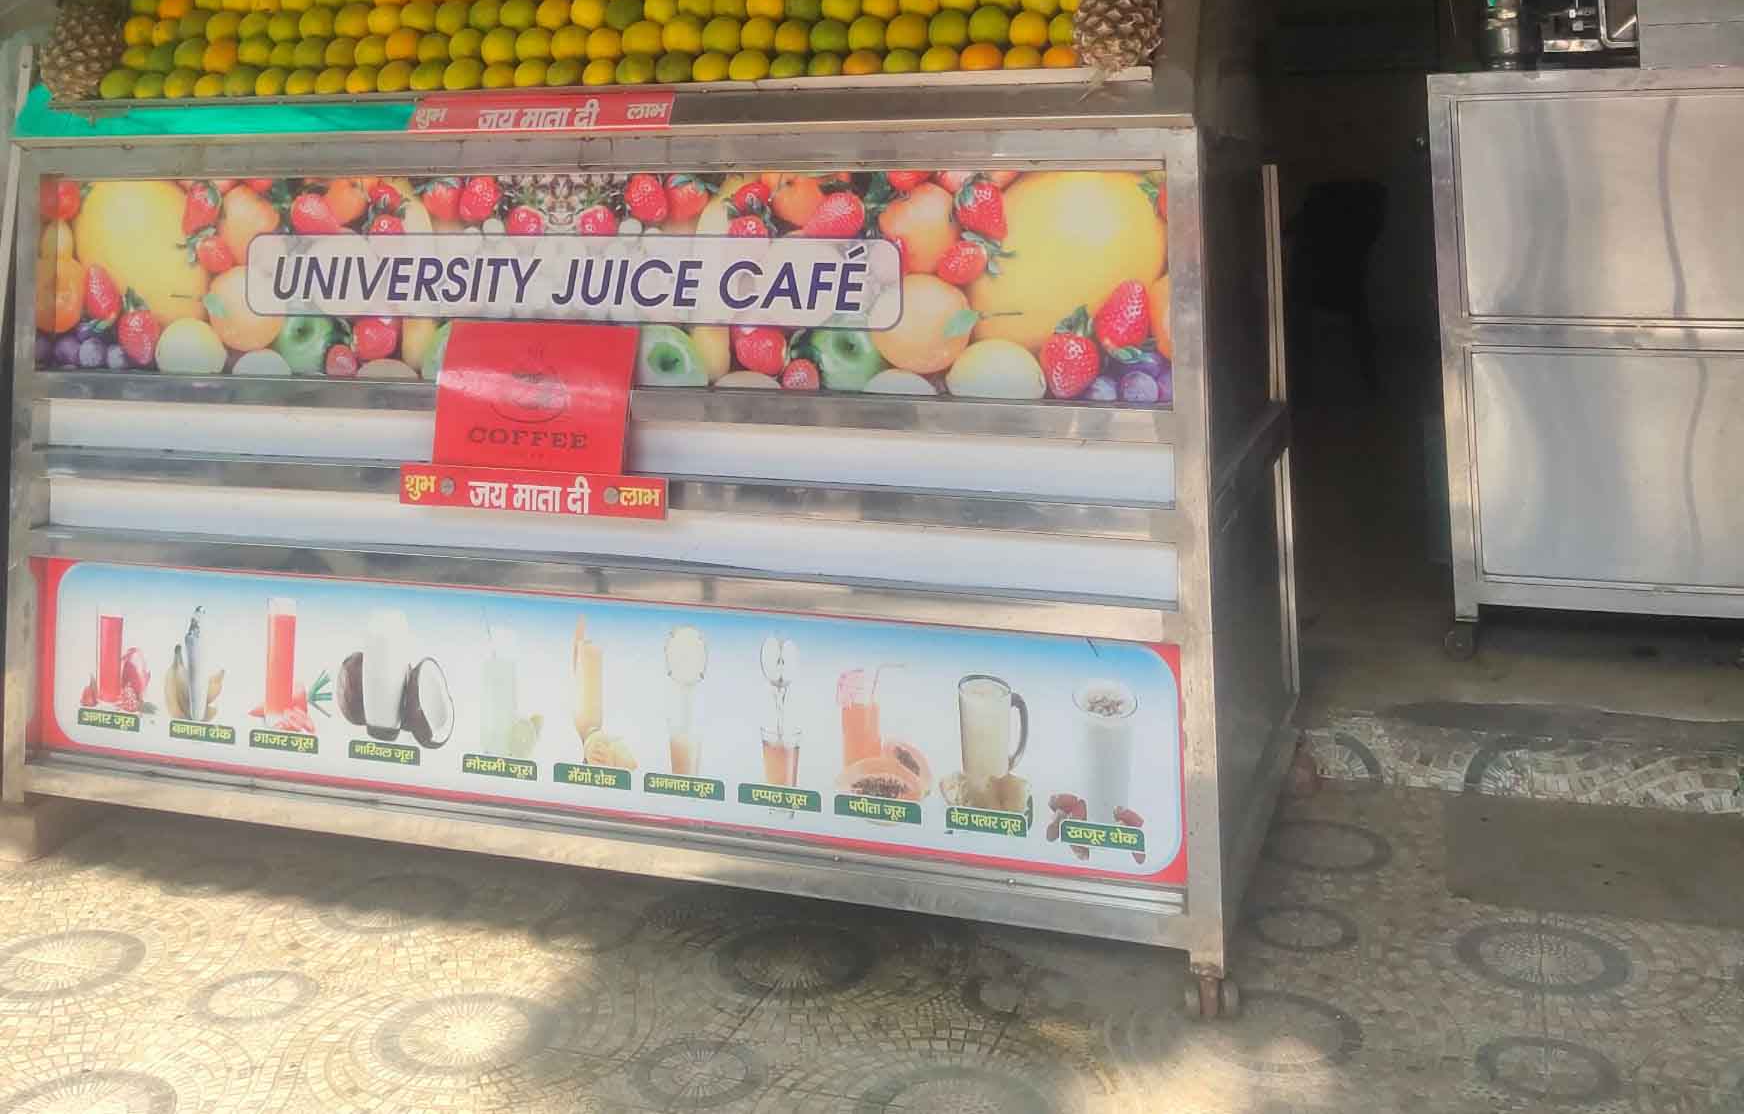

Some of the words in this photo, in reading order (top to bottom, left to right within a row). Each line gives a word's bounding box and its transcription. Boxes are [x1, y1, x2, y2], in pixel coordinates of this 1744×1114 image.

[415, 107, 448, 129] शुभ
[478, 109, 515, 130] जय
[519, 106, 571, 129] माता
[573, 98, 600, 128] दी
[626, 102, 669, 120] लाभ
[272, 254, 542, 304] UNIVERSITY
[550, 257, 700, 307] JUICE
[719, 244, 869, 312] CAFÉ
[467, 426, 588, 451] COFFEE
[404, 474, 436, 501] शुभ
[467, 481, 508, 509] जय
[512, 483, 562, 513] माता
[566, 475, 592, 514] दी
[618, 486, 662, 507] लाभ
[113, 715, 136, 732] जूस
[253, 731, 288, 747] गाजर
[290, 735, 315, 753] जूस
[393, 748, 415, 766] जूस
[507, 764, 534, 780] जूस
[692, 781, 715, 799] जूस
[784, 792, 808, 809] जूस
[848, 797, 881, 815] पपीता
[882, 804, 906, 822] जूस
[999, 817, 1022, 838] जूस
[1066, 825, 1106, 846] खजूर
[1109, 828, 1138, 846] शेक
